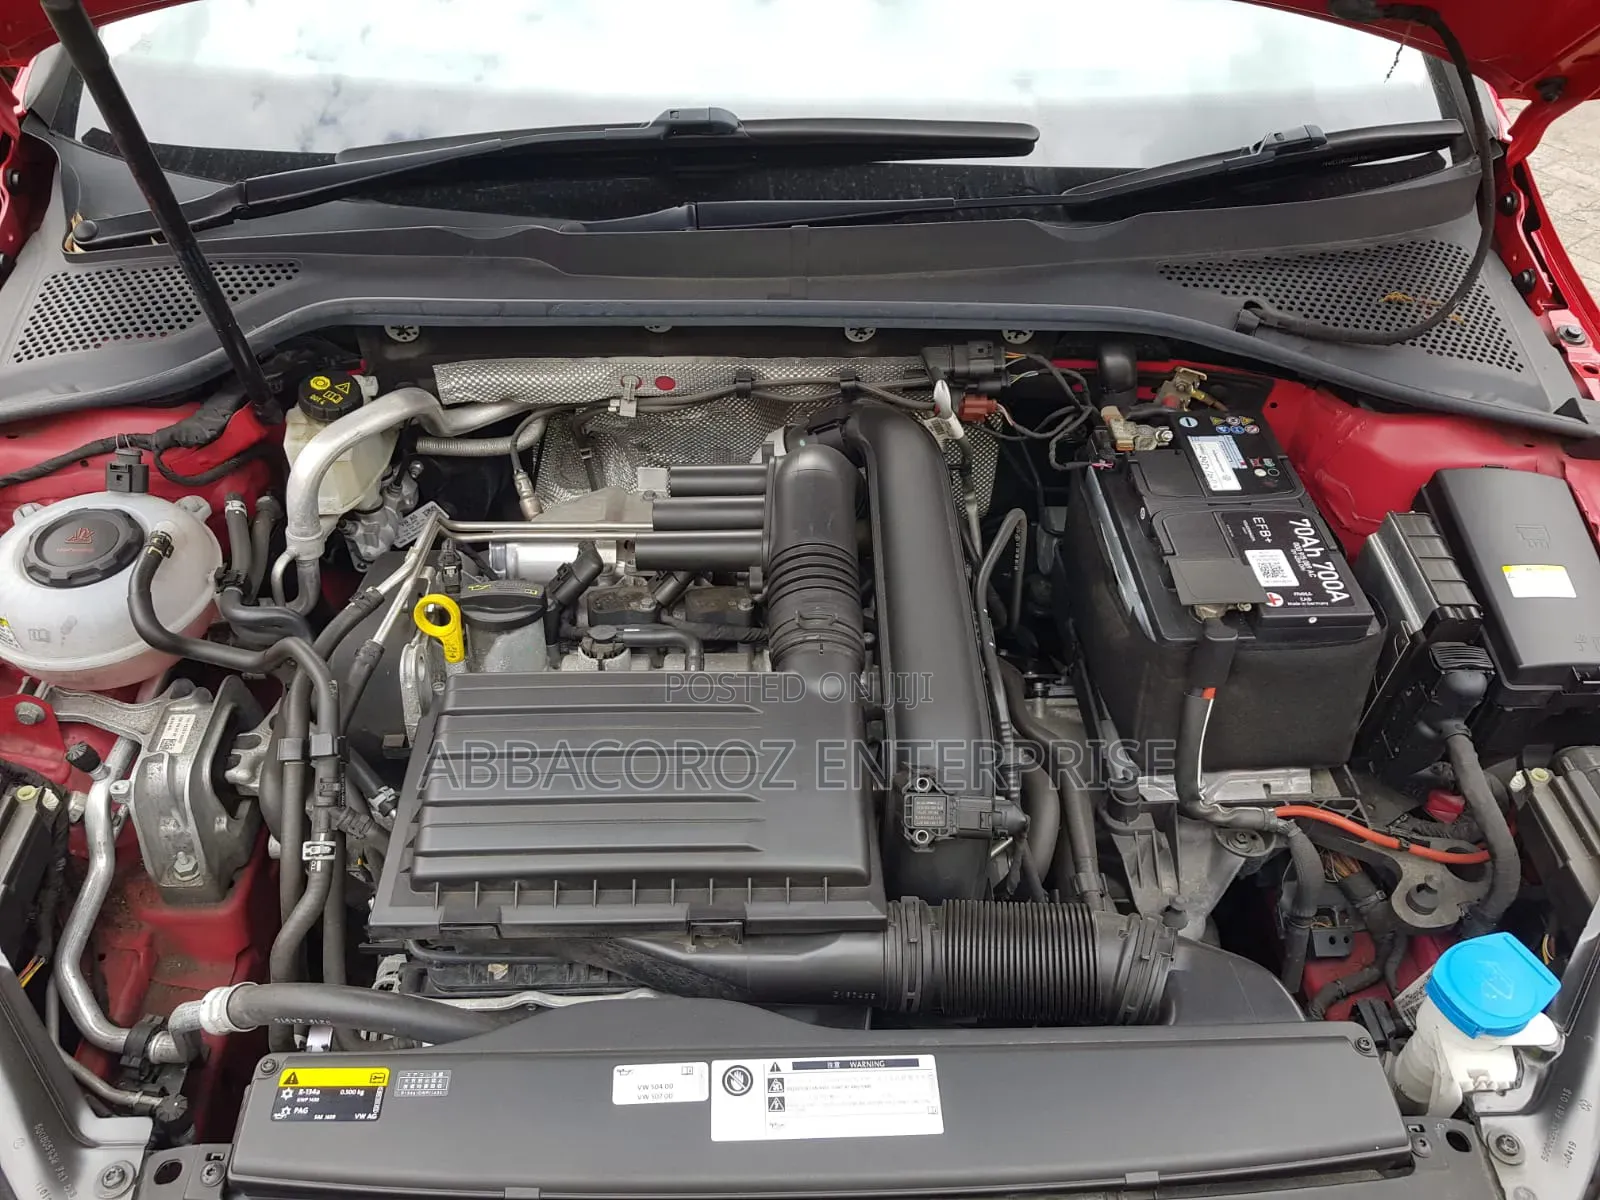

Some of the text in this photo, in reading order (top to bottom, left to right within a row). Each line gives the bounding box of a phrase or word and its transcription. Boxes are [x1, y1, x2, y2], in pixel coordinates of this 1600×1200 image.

[1252, 516, 1273, 543] EFB+
[1288, 518, 1325, 558] 70Ah
[1312, 561, 1350, 602] 700A
[850, 1060, 885, 1068] WARNING
[294, 1106, 309, 1114] PAG
